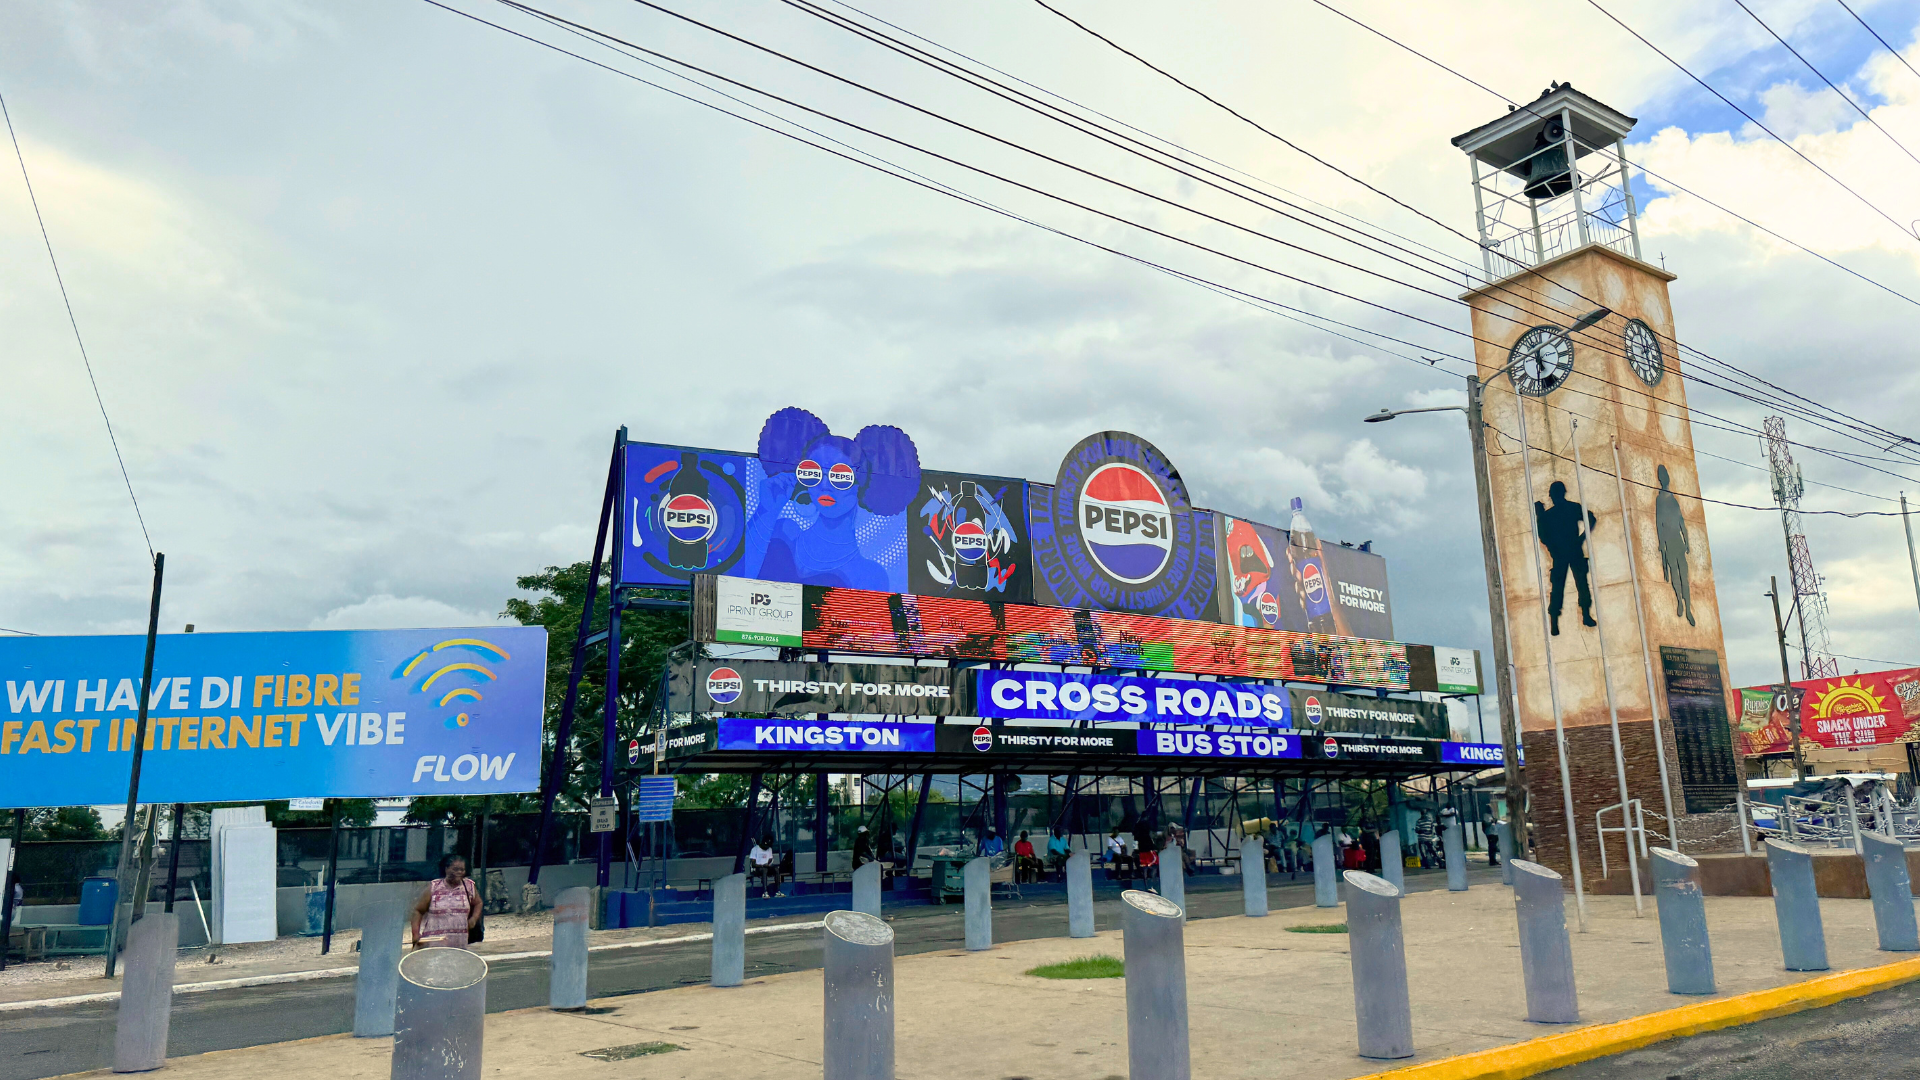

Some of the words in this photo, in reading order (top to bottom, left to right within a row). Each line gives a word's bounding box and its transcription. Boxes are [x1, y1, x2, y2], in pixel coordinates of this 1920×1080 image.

[797, 469, 821, 478] PEPSI
[829, 472, 853, 481] PEPSI
[667, 511, 711, 525] PEPSI
[1084, 504, 1168, 540] PEPSI
[955, 536, 986, 547] PEPSI
[1304, 577, 1321, 589] PEPSI
[1338, 581, 1383, 602] THIRSTY
[1261, 603, 1277, 613] PEPSI
[1339, 595, 1360, 609] FOR
[1360, 598, 1386, 614] MORE
[759, 608, 793, 619] GROUP
[6, 679, 65, 713] WI
[75, 677, 192, 711] HAVE
[200, 676, 243, 709] DI
[253, 673, 361, 708] FIBRE
[708, 680, 741, 690] PEPSI
[753, 679, 847, 695] THIRSTY
[851, 682, 892, 696] FOR
[894, 684, 950, 698] MORE
[991, 678, 1148, 715] CROSS
[1155, 687, 1284, 721] ROADS
[1306, 706, 1321, 714] PEPSI
[1326, 706, 1367, 719] THIRSTY
[1369, 710, 1389, 721] FOR
[1389, 713, 1416, 723] MORE
[0, 719, 100, 754] FAST
[108, 714, 308, 752] INTERNET
[314, 711, 406, 746] VIBE
[1816, 718, 1853, 733] SNACK
[1853, 715, 1888, 730] UNDER
[669, 737, 683, 749] FOR
[684, 732, 706, 746] MORE
[755, 726, 900, 746] KINGSTON
[998, 735, 1052, 746] THIRSTY
[1054, 736, 1079, 746] FOR
[1080, 737, 1114, 747] MORE
[1156, 732, 1213, 755] BUS
[1217, 734, 1288, 756] STOP
[1832, 731, 1853, 745] THE
[1854, 729, 1876, 744] SUN
[1341, 744, 1380, 754] THIRSTY
[1381, 745, 1398, 754] FOR
[1399, 746, 1423, 755] MORE
[412, 752, 516, 783] FLOW
